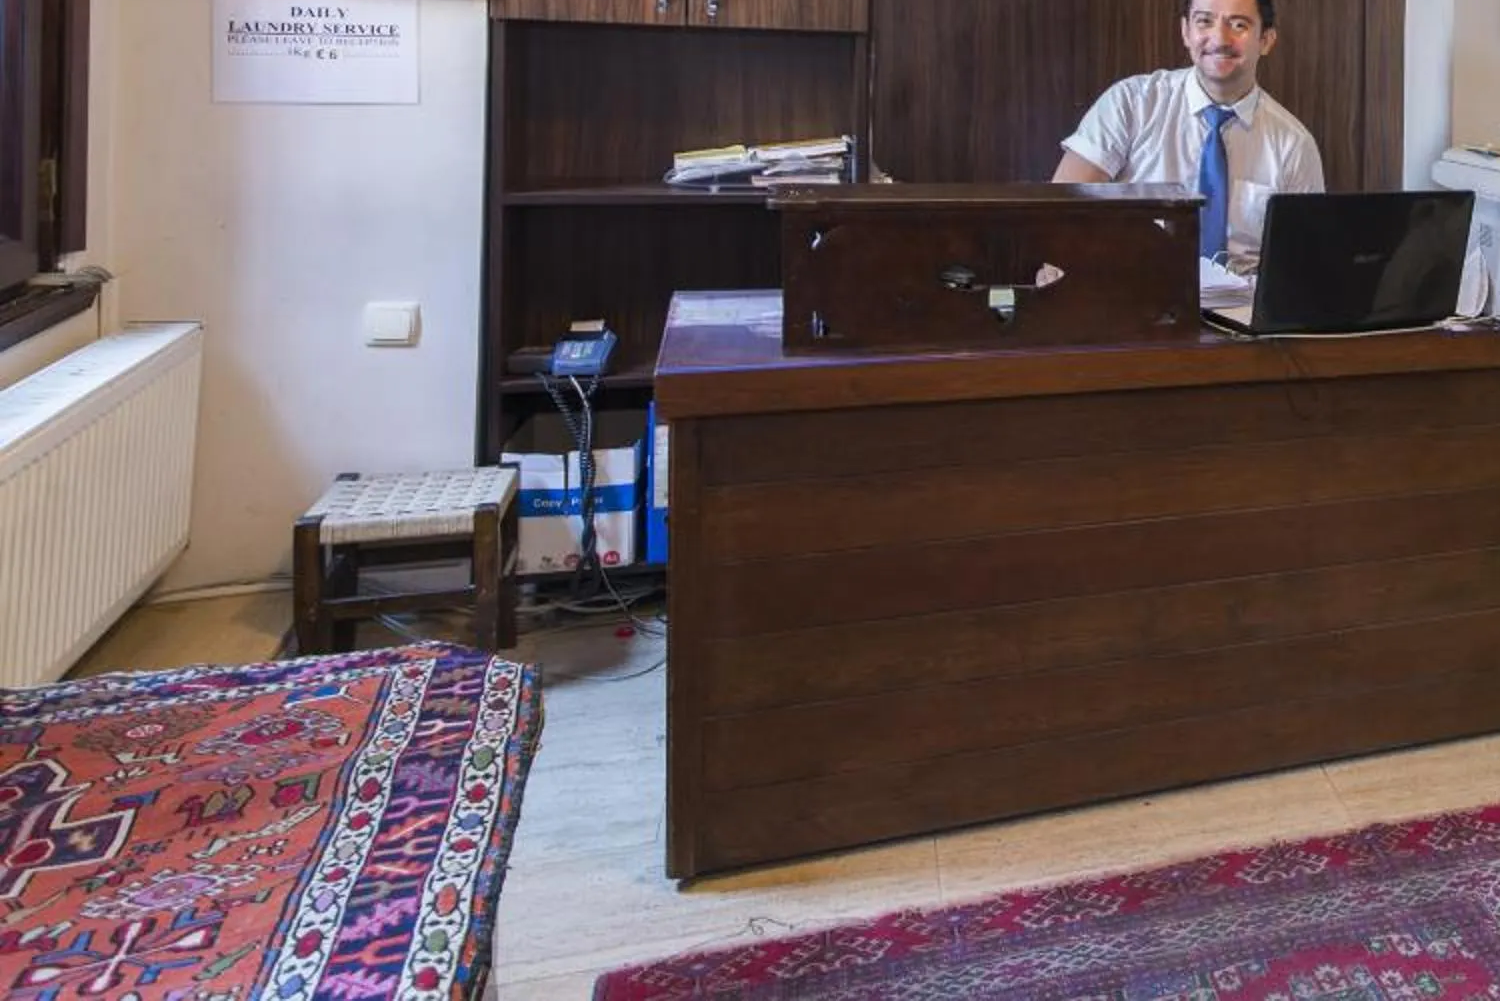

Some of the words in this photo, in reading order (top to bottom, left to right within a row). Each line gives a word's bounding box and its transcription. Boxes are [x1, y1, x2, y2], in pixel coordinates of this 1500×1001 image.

[291, 6, 350, 18] DAILY
[228, 20, 315, 34] LAUNDRY
[323, 23, 400, 36] SERVICE
